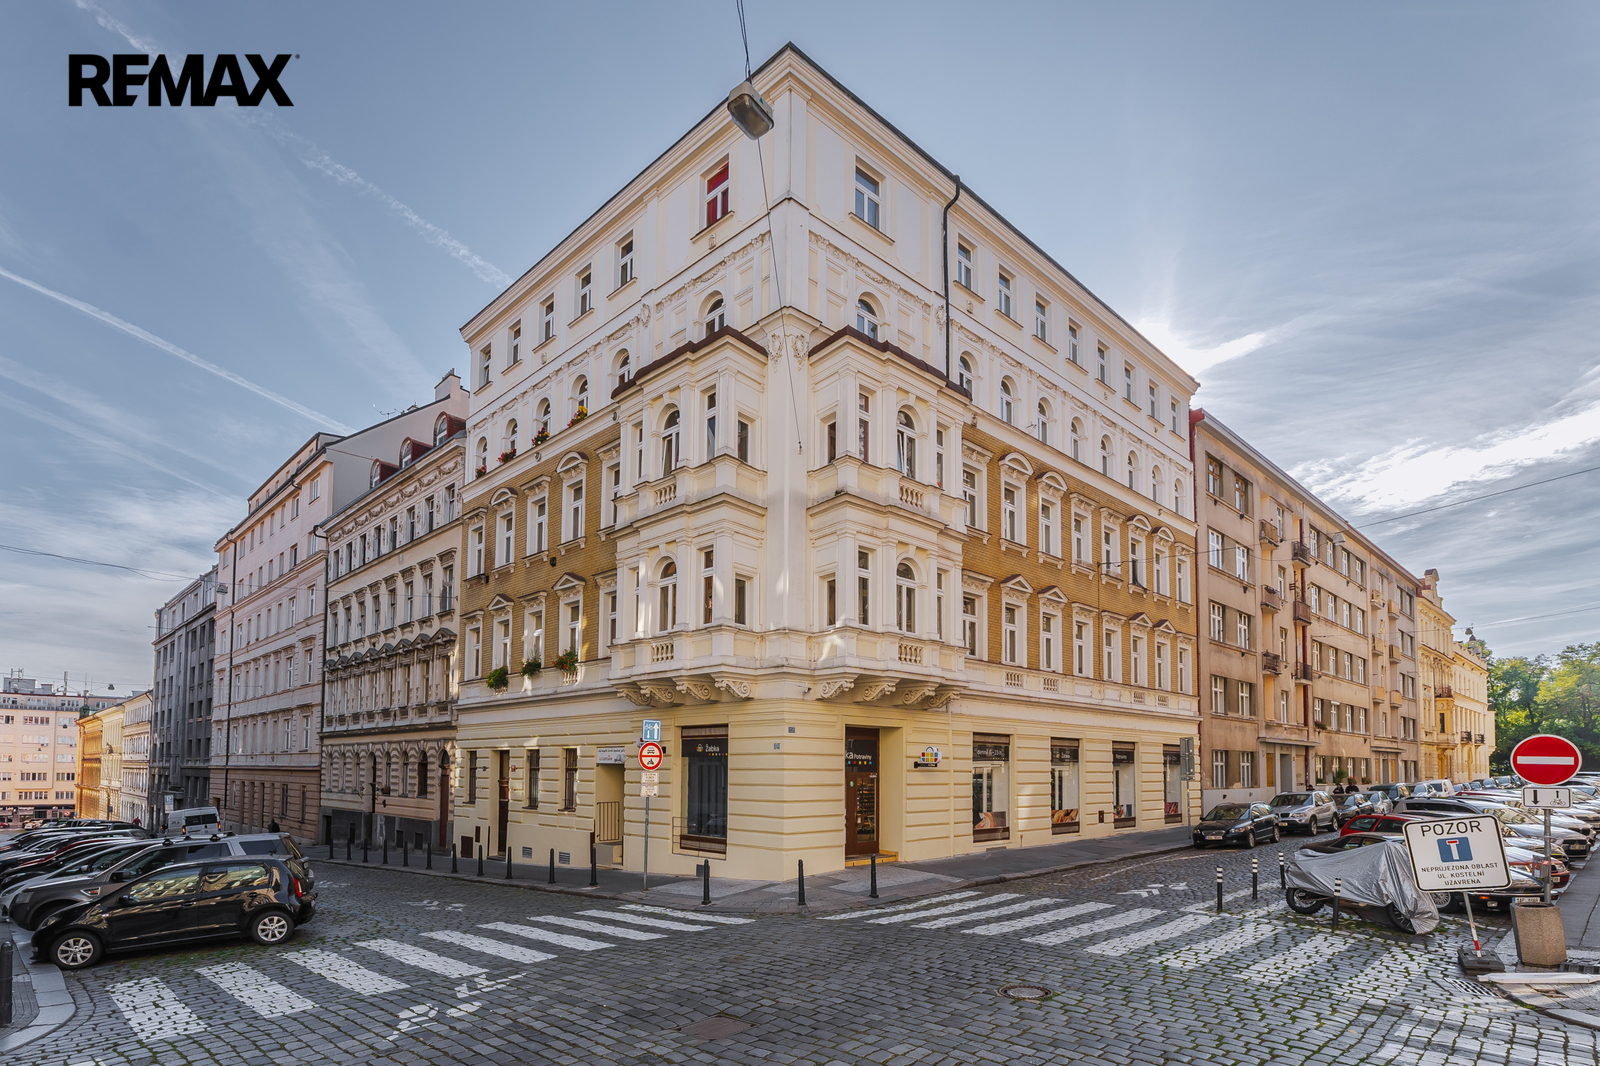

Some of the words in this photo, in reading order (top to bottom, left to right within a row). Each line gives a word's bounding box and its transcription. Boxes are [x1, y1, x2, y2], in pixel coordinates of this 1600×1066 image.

[705, 744, 720, 752] Žabka
[853, 753, 873, 761] Potraviny
[1420, 820, 1483, 837] POZOR
[1471, 862, 1498, 870] OBLAST
[1450, 870, 1485, 878] KOSTELNÍ
